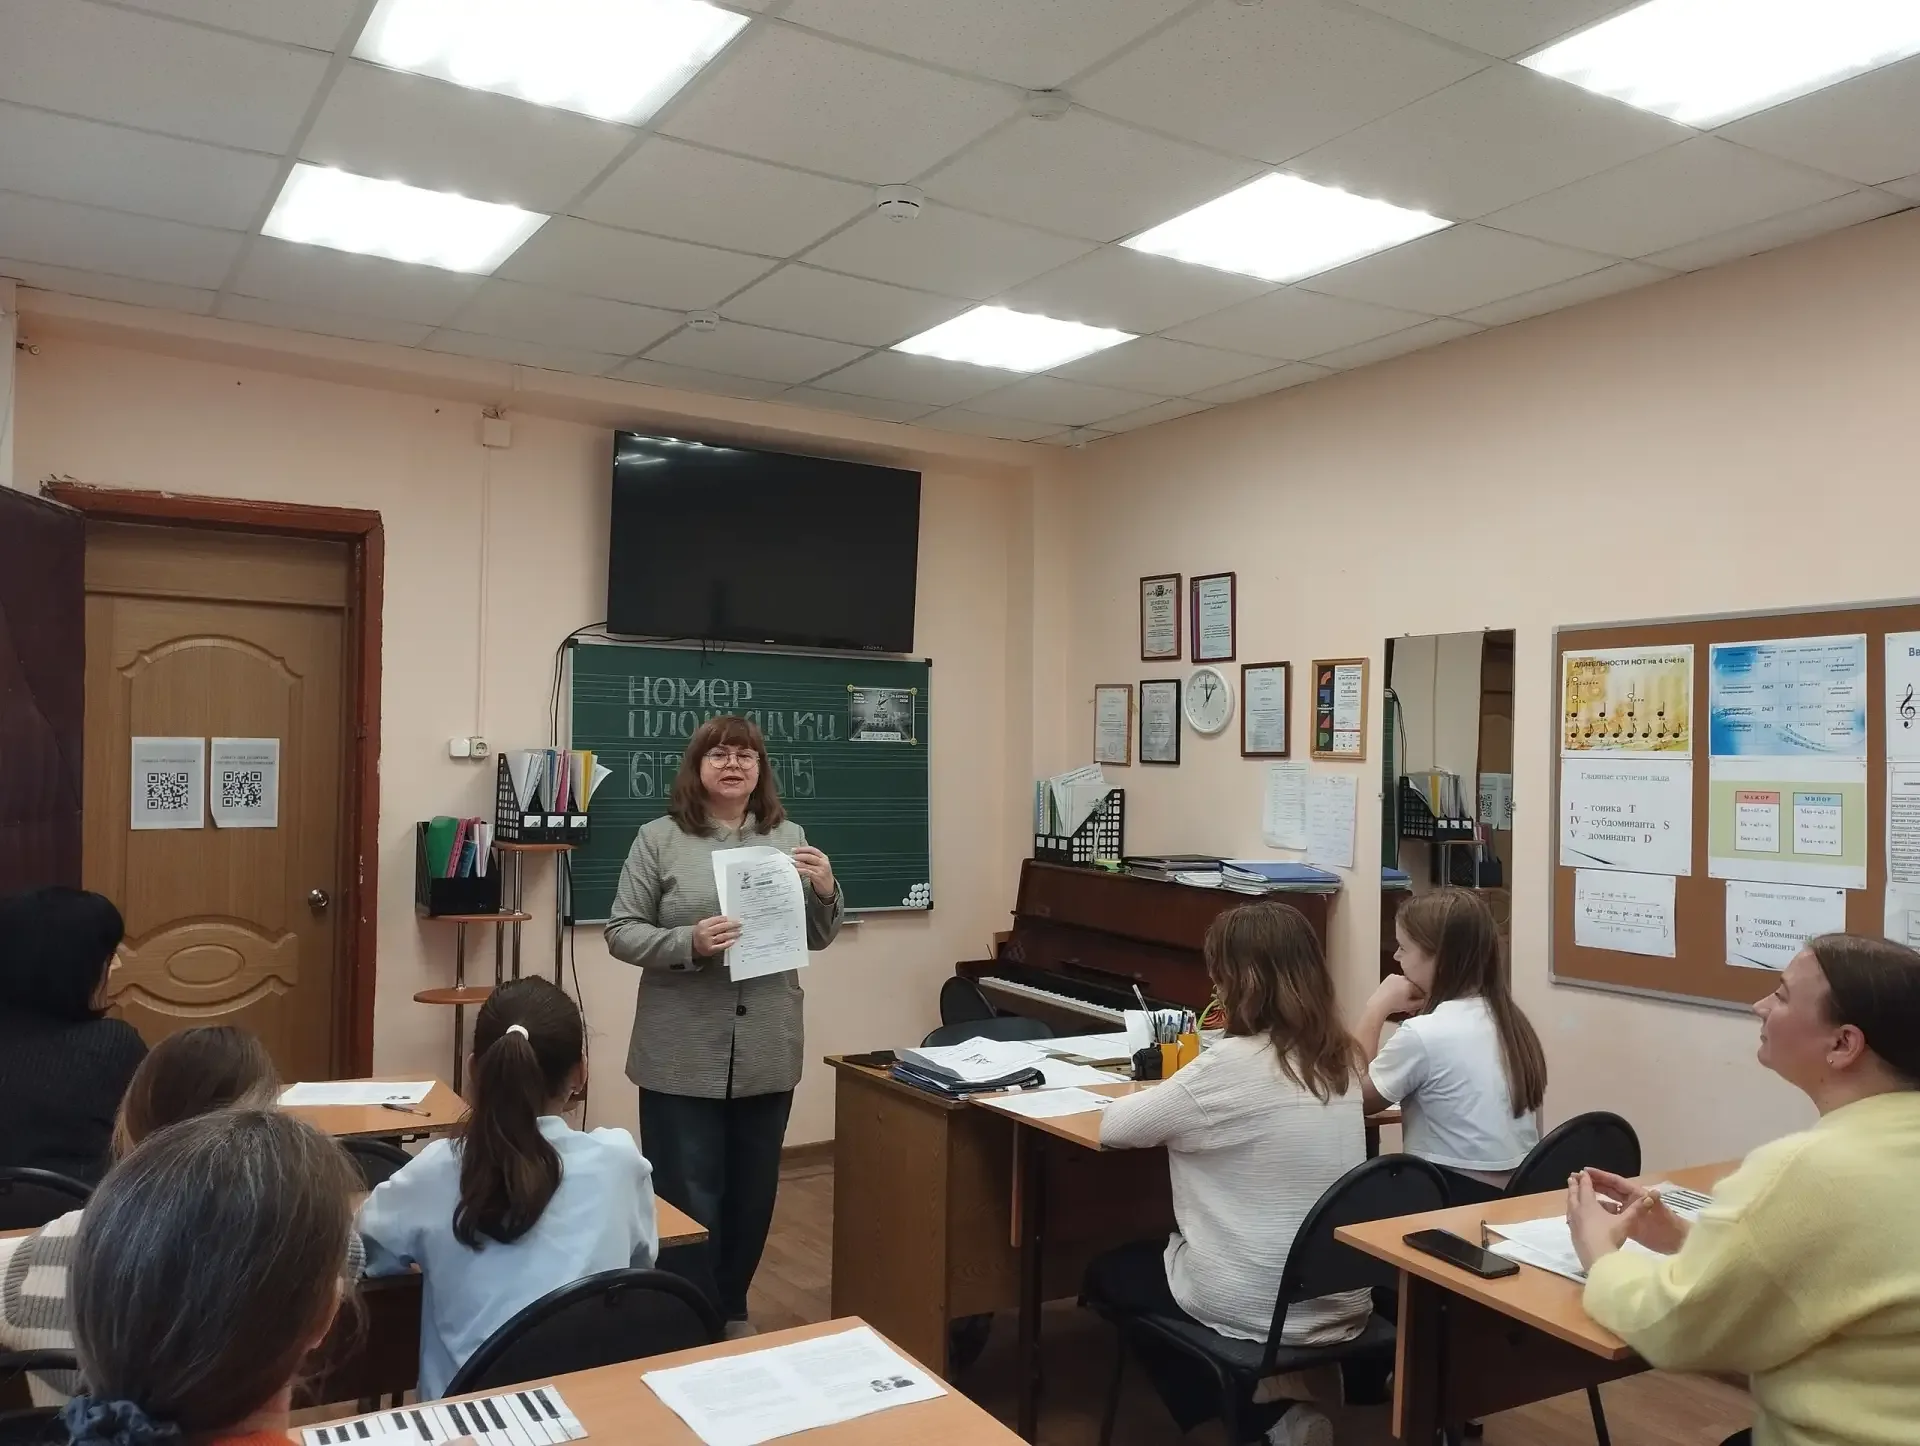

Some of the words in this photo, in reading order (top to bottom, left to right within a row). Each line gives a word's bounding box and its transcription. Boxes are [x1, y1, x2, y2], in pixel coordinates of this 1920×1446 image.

[1574, 659, 1630, 668] ДЛИТЕЛЬНОСТИ
[1631, 658, 1646, 666] НОТ
[1580, 772, 1614, 780] Главные
[1570, 802, 1574, 811] I
[1591, 804, 1622, 813] тоника
[1628, 804, 1636, 813] T
[1570, 815, 1581, 825] IV
[1591, 818, 1656, 829] субдоминанта
[1663, 820, 1670, 830] S
[1569, 829, 1577, 838] V
[1588, 833, 1636, 843] доминанта
[1643, 834, 1652, 843] D
[1753, 917, 1782, 926] тоника
[1735, 926, 1745, 934] IV
[1736, 937, 1742, 945] V
[1752, 941, 1796, 951] доминанта
